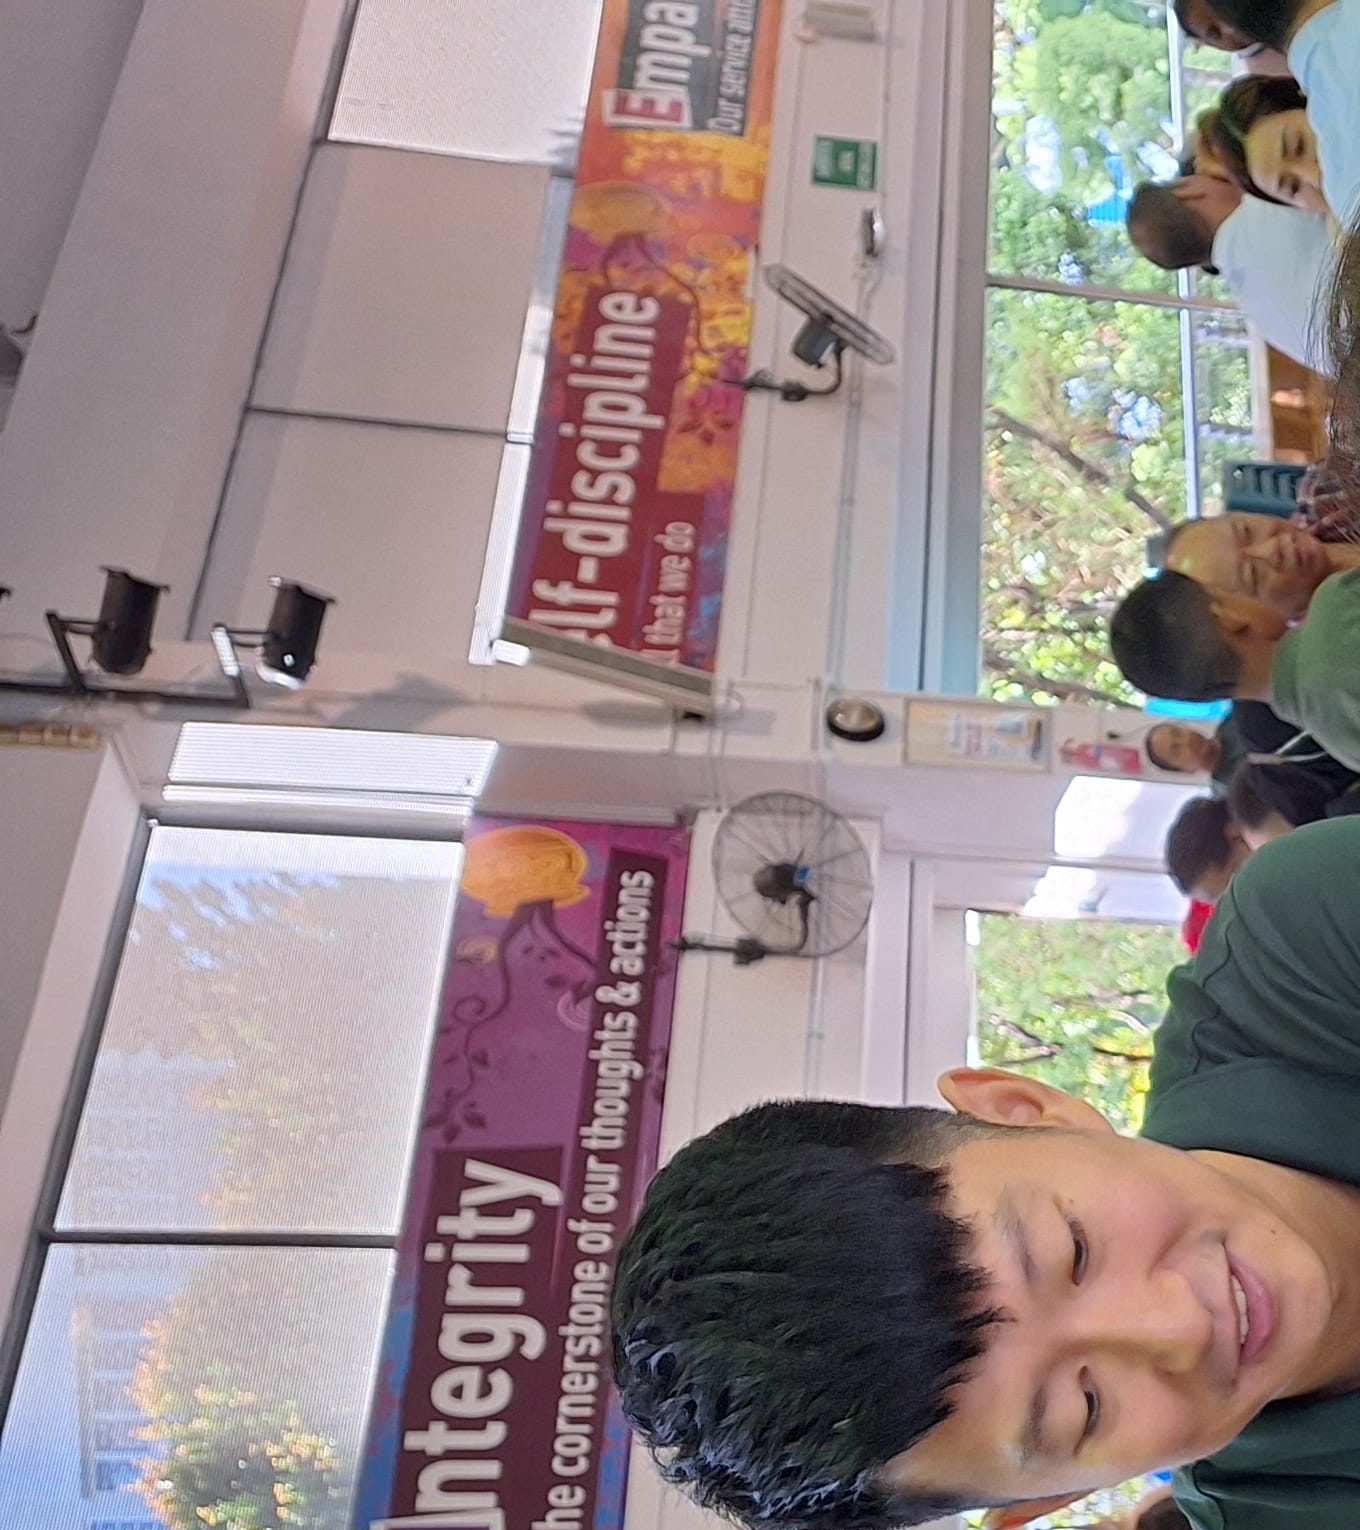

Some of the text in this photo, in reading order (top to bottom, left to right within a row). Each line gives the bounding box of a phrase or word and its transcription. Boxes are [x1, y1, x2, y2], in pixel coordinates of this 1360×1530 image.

[707, 100, 746, 132] Our
[642, 522, 696, 645] that we do
[604, 870, 654, 976] actions
[596, 981, 641, 1004] &
[581, 1012, 646, 1150] thoughts
[581, 1154, 619, 1214] our
[568, 1217, 615, 1254] of
[549, 1261, 610, 1476] cornerstone
